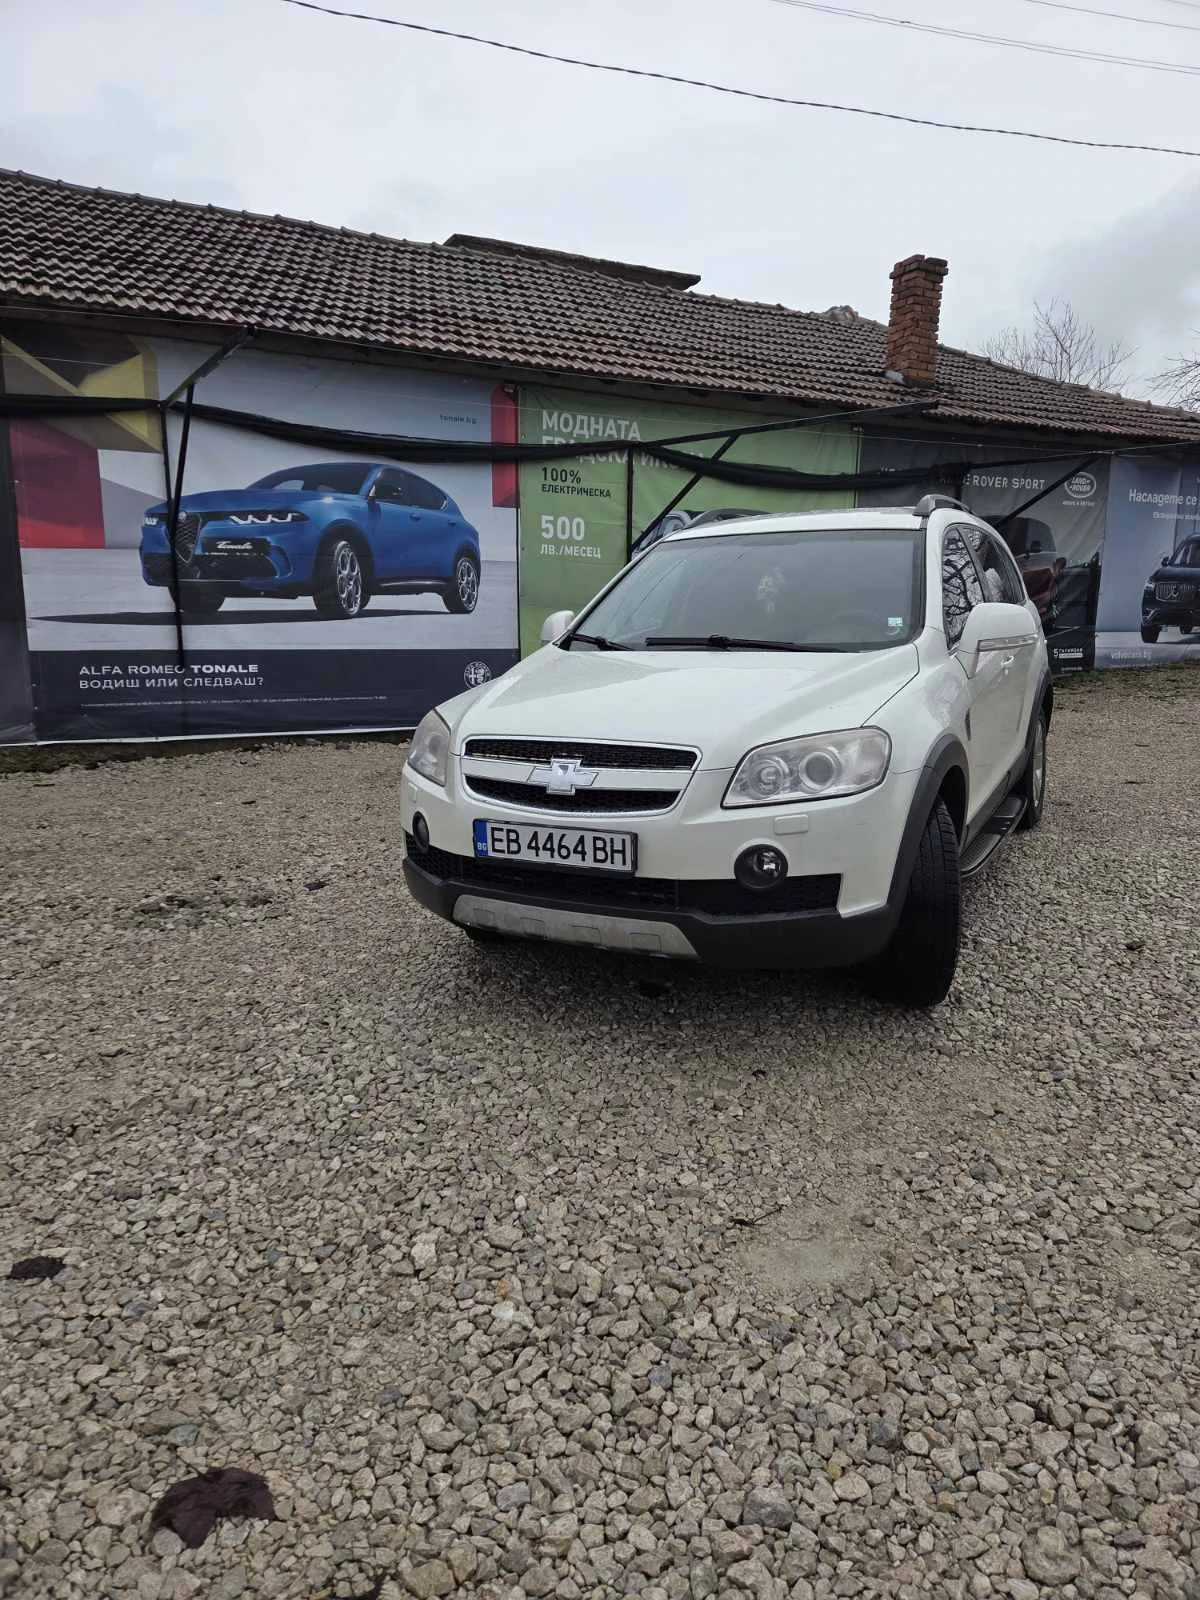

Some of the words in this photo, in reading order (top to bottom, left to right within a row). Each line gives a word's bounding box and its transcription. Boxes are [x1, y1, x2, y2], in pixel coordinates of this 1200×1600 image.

[541, 409, 642, 441] МОДНАТА
[541, 466, 582, 484] 100%
[973, 474, 1008, 488] ROVER
[1011, 477, 1046, 490] SPORT
[541, 483, 612, 499] ЕЛЕКТРИЧЕСКА
[541, 514, 585, 541] 500
[540, 543, 602, 559] ЛВ./МЕСЕЦ
[79, 665, 123, 676] ALFA
[128, 664, 185, 675] ROMEO
[190, 664, 259, 674] TONALE
[79, 679, 140, 691] ВОДИШ
[145, 678, 179, 688] ИЛИ
[183, 676, 264, 688] СЛЕДВАШ?
[477, 841, 487, 850] BG
[490, 826, 522, 855] EB
[527, 831, 587, 861] 4464
[592, 836, 627, 866] BH
